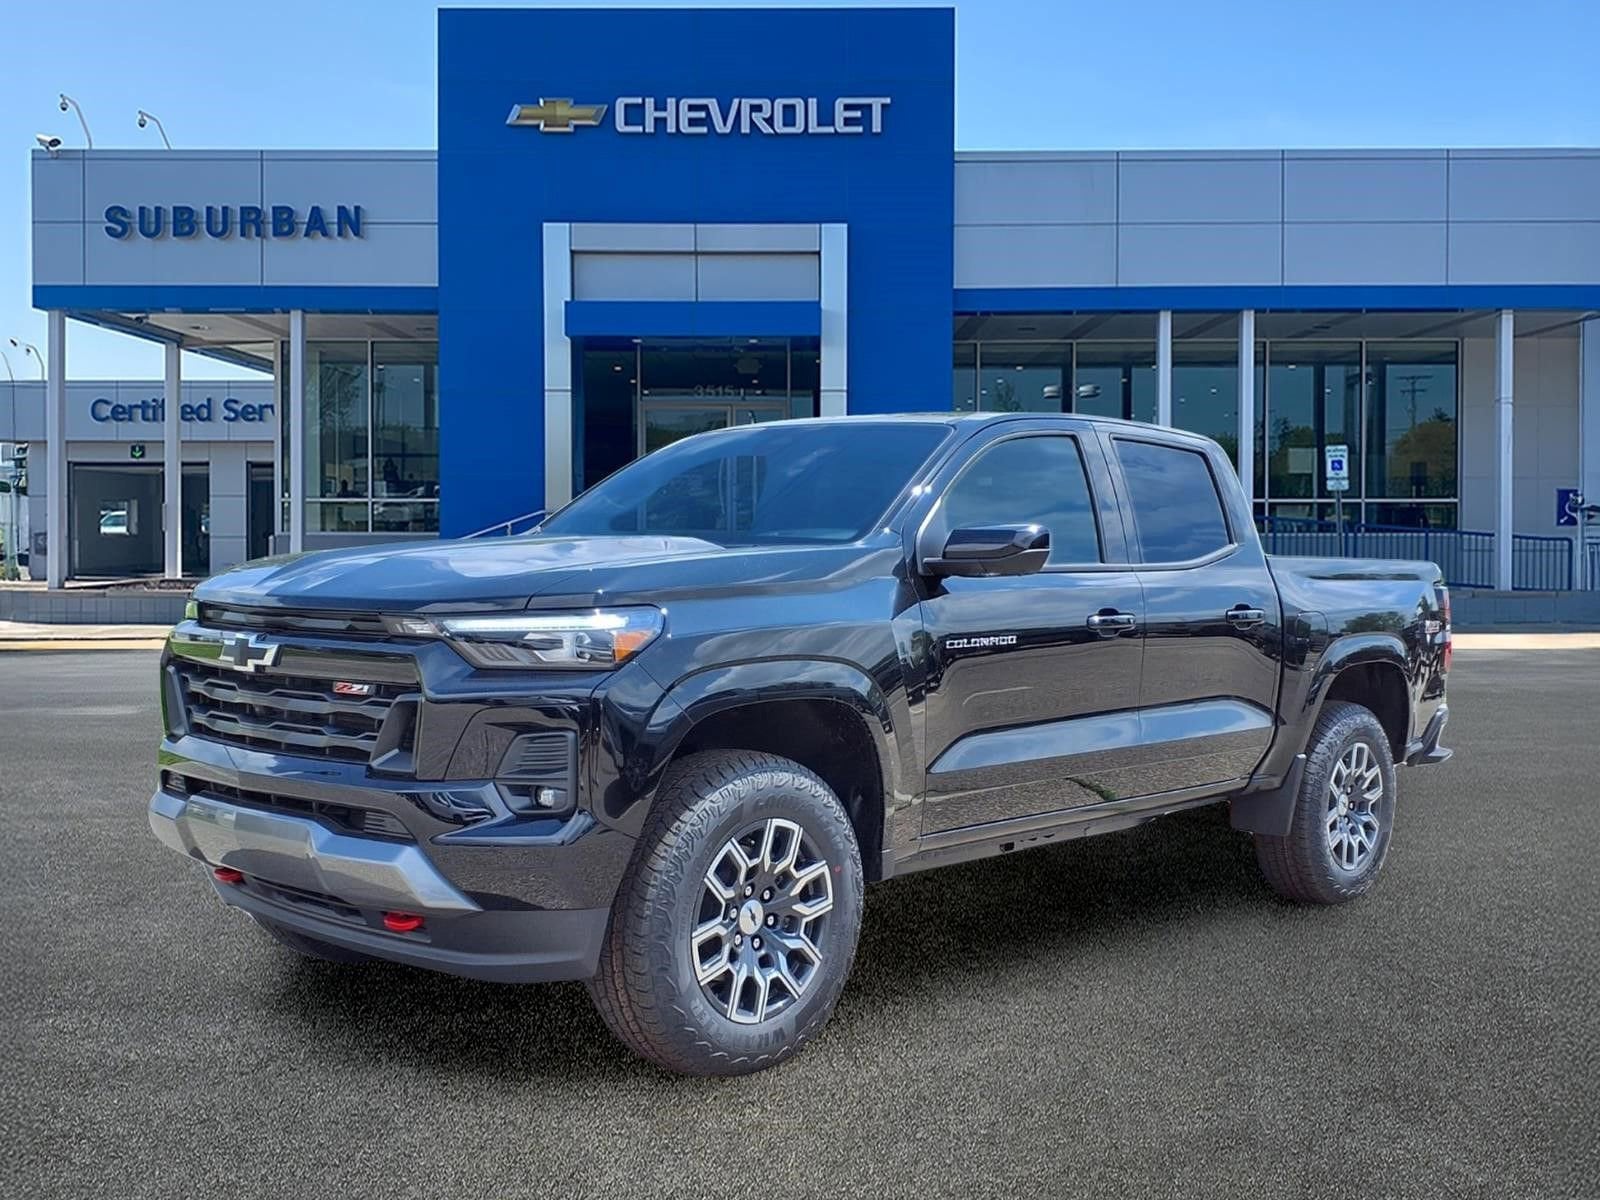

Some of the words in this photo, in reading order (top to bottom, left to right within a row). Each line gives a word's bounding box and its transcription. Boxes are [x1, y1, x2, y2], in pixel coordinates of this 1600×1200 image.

[614, 96, 891, 135] CHEVROLET
[104, 205, 362, 238] SUBURBAN
[90, 397, 212, 423] Certifed
[945, 635, 1017, 649] COLORADO
[335, 681, 369, 696] Z71
